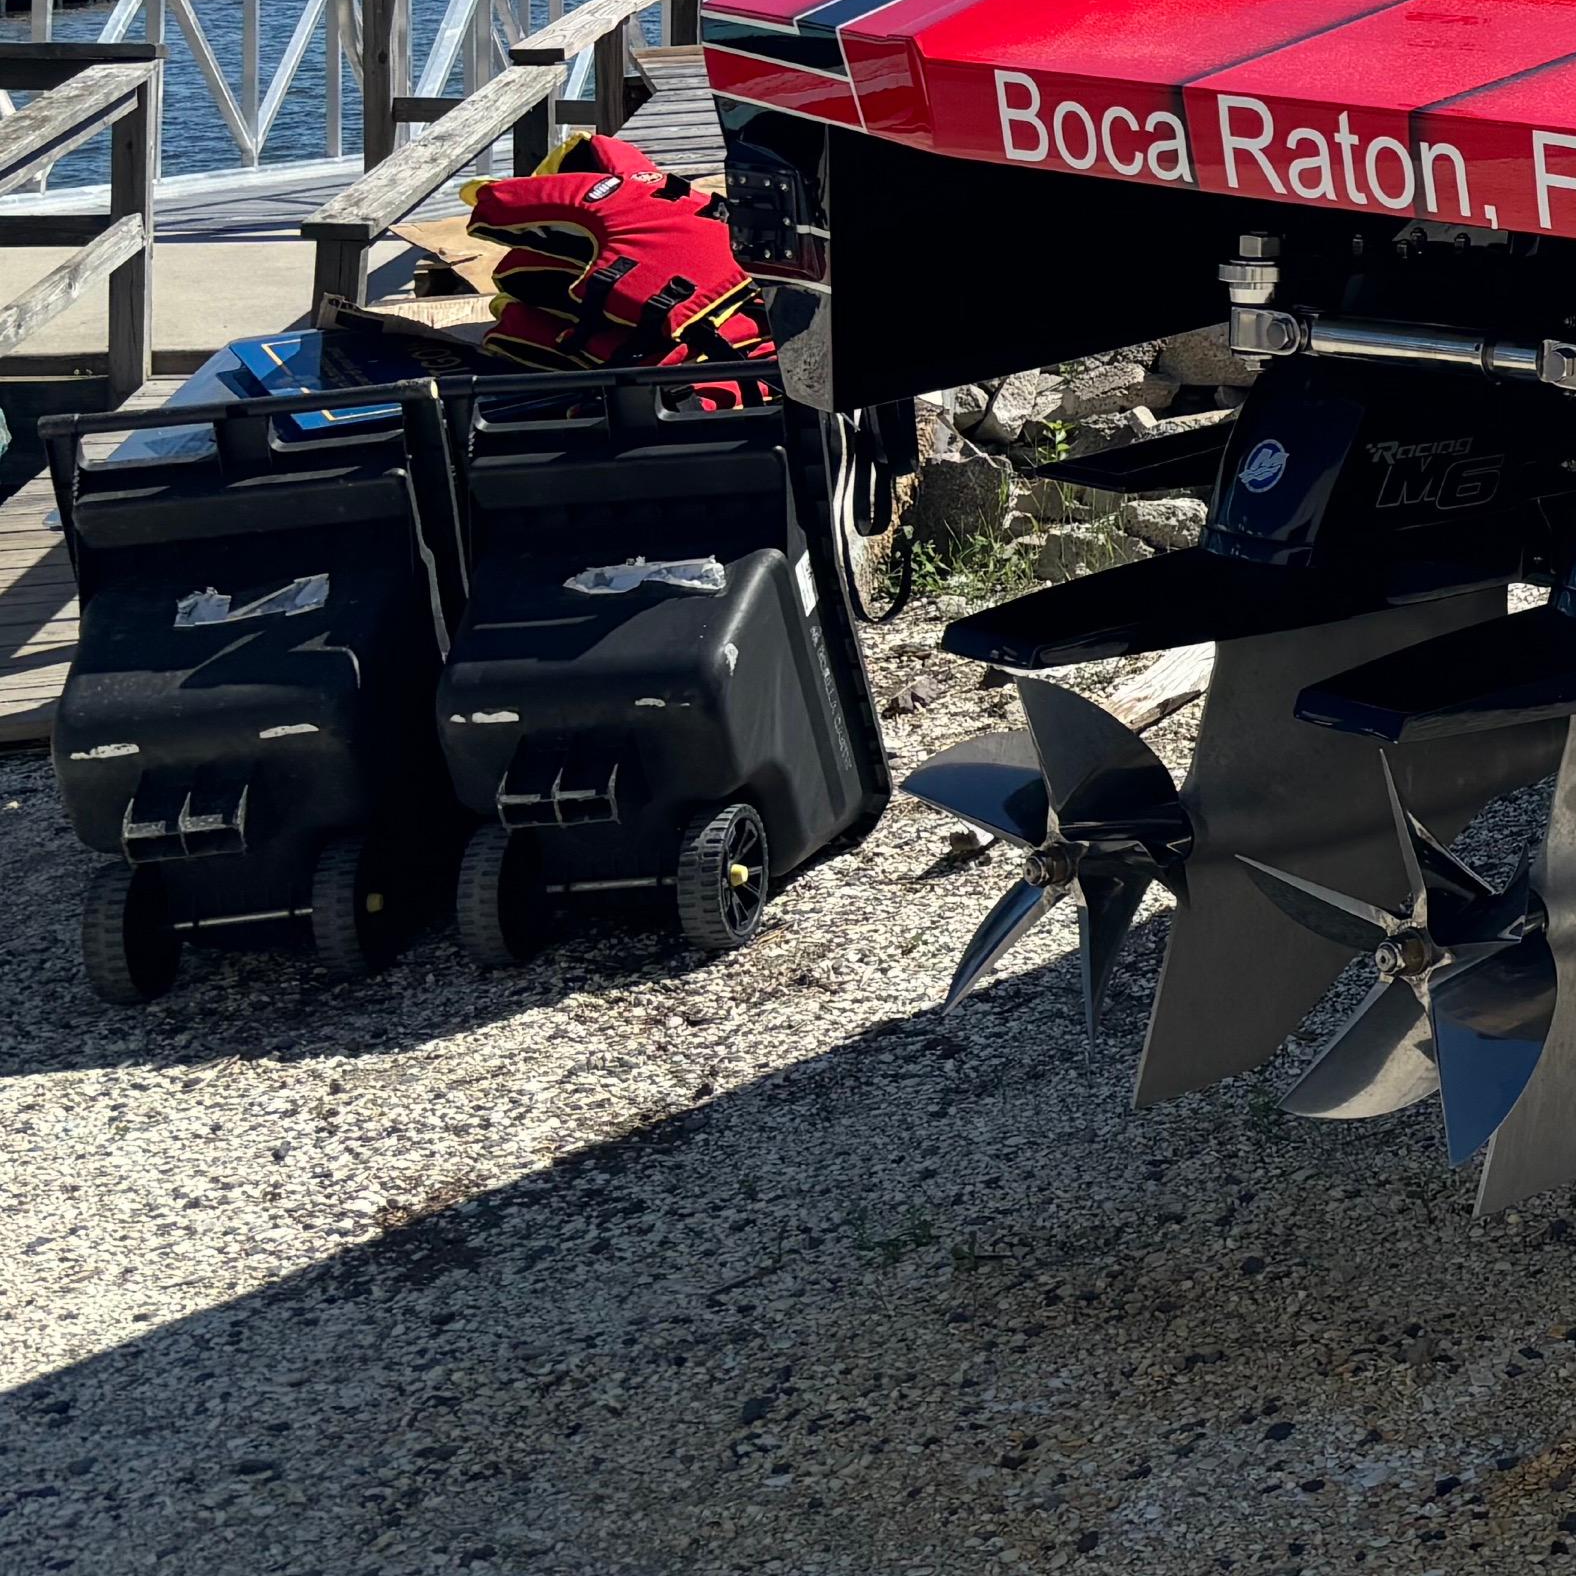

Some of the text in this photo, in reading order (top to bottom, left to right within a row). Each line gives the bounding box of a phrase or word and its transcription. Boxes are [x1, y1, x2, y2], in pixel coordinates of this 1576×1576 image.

[995, 69, 1195, 183] Boca
[1217, 94, 1499, 230] Raton,
[1371, 436, 1474, 465] Racing
[1375, 454, 1504, 510] M6
